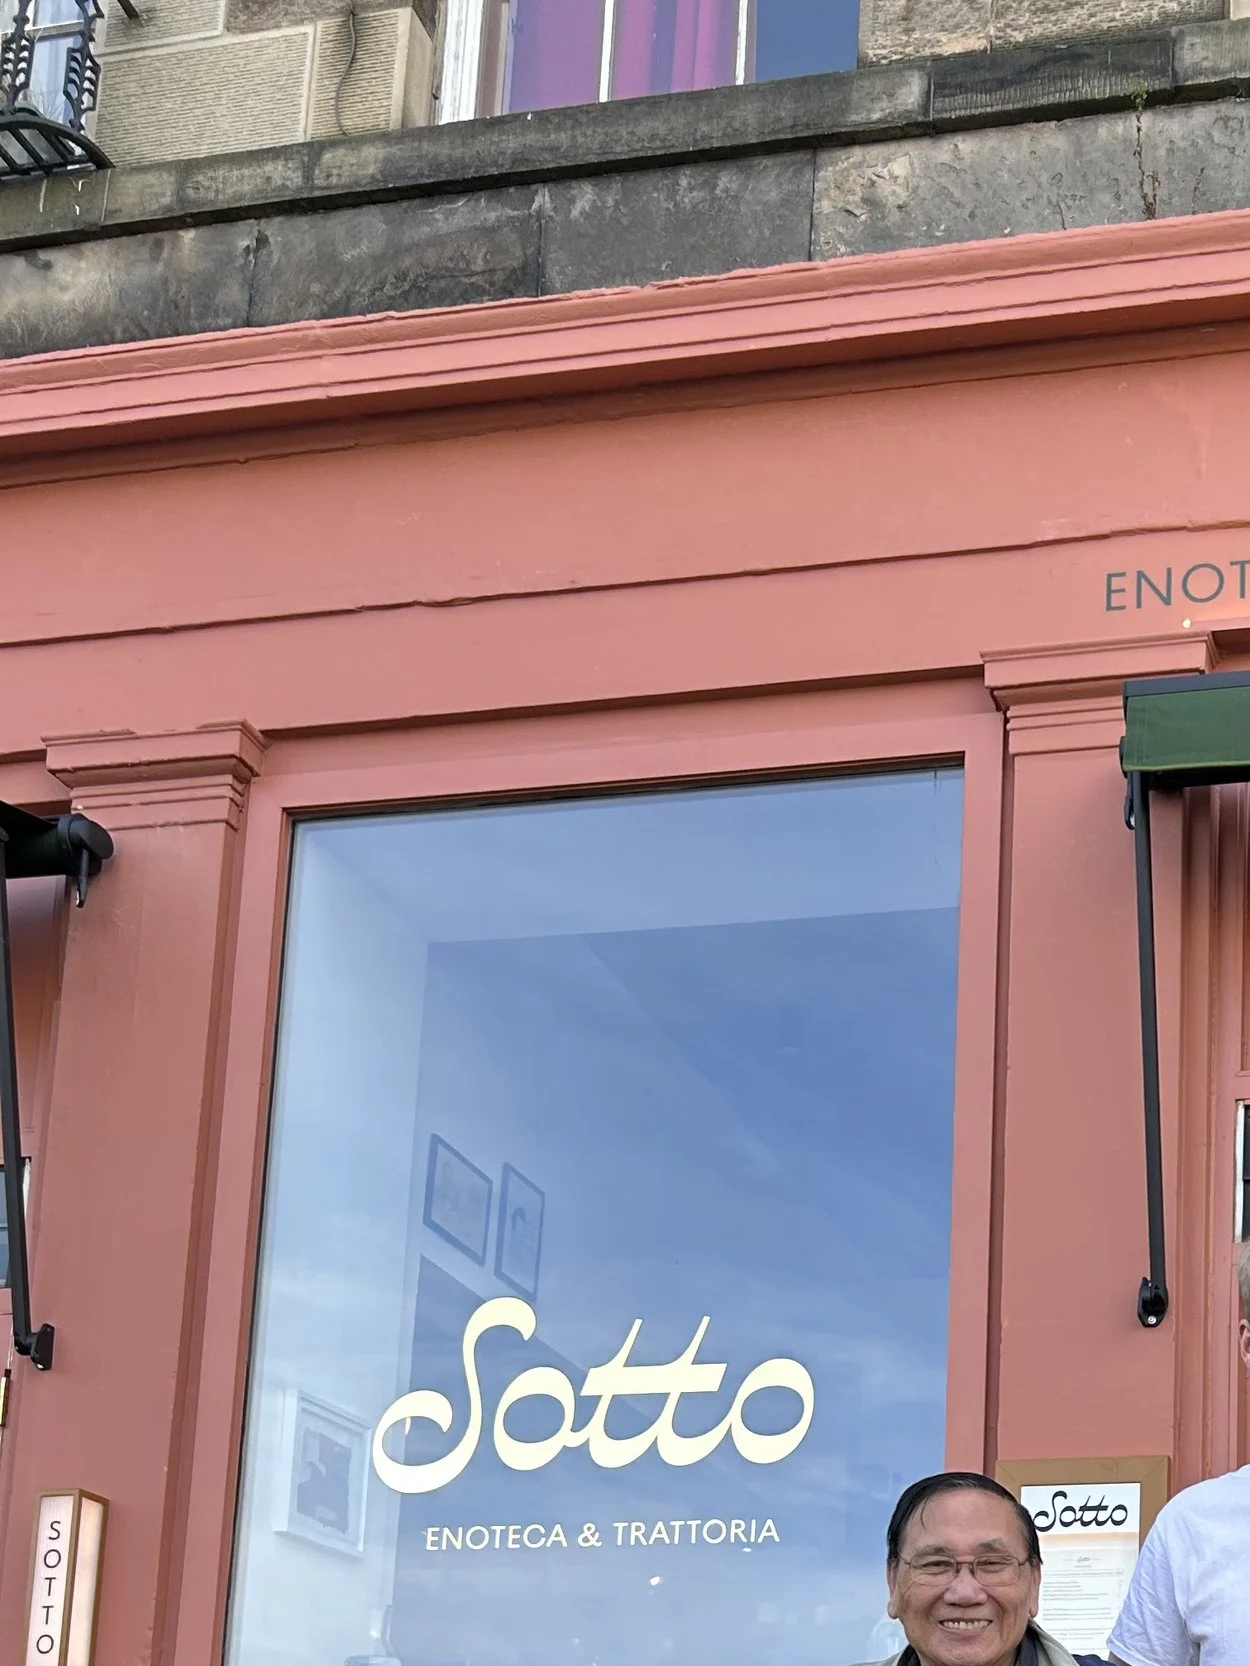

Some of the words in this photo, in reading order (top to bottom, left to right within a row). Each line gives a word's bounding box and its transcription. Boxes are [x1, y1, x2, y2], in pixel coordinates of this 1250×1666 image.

[372, 1296, 815, 1494] Sotto
[425, 1523, 567, 1551] ENOTECA
[577, 1523, 603, 1547] &
[613, 1519, 780, 1546] TRATTORIA
[1033, 1490, 1128, 1532] Sotto
[36, 1520, 62, 1655] SOTTO
